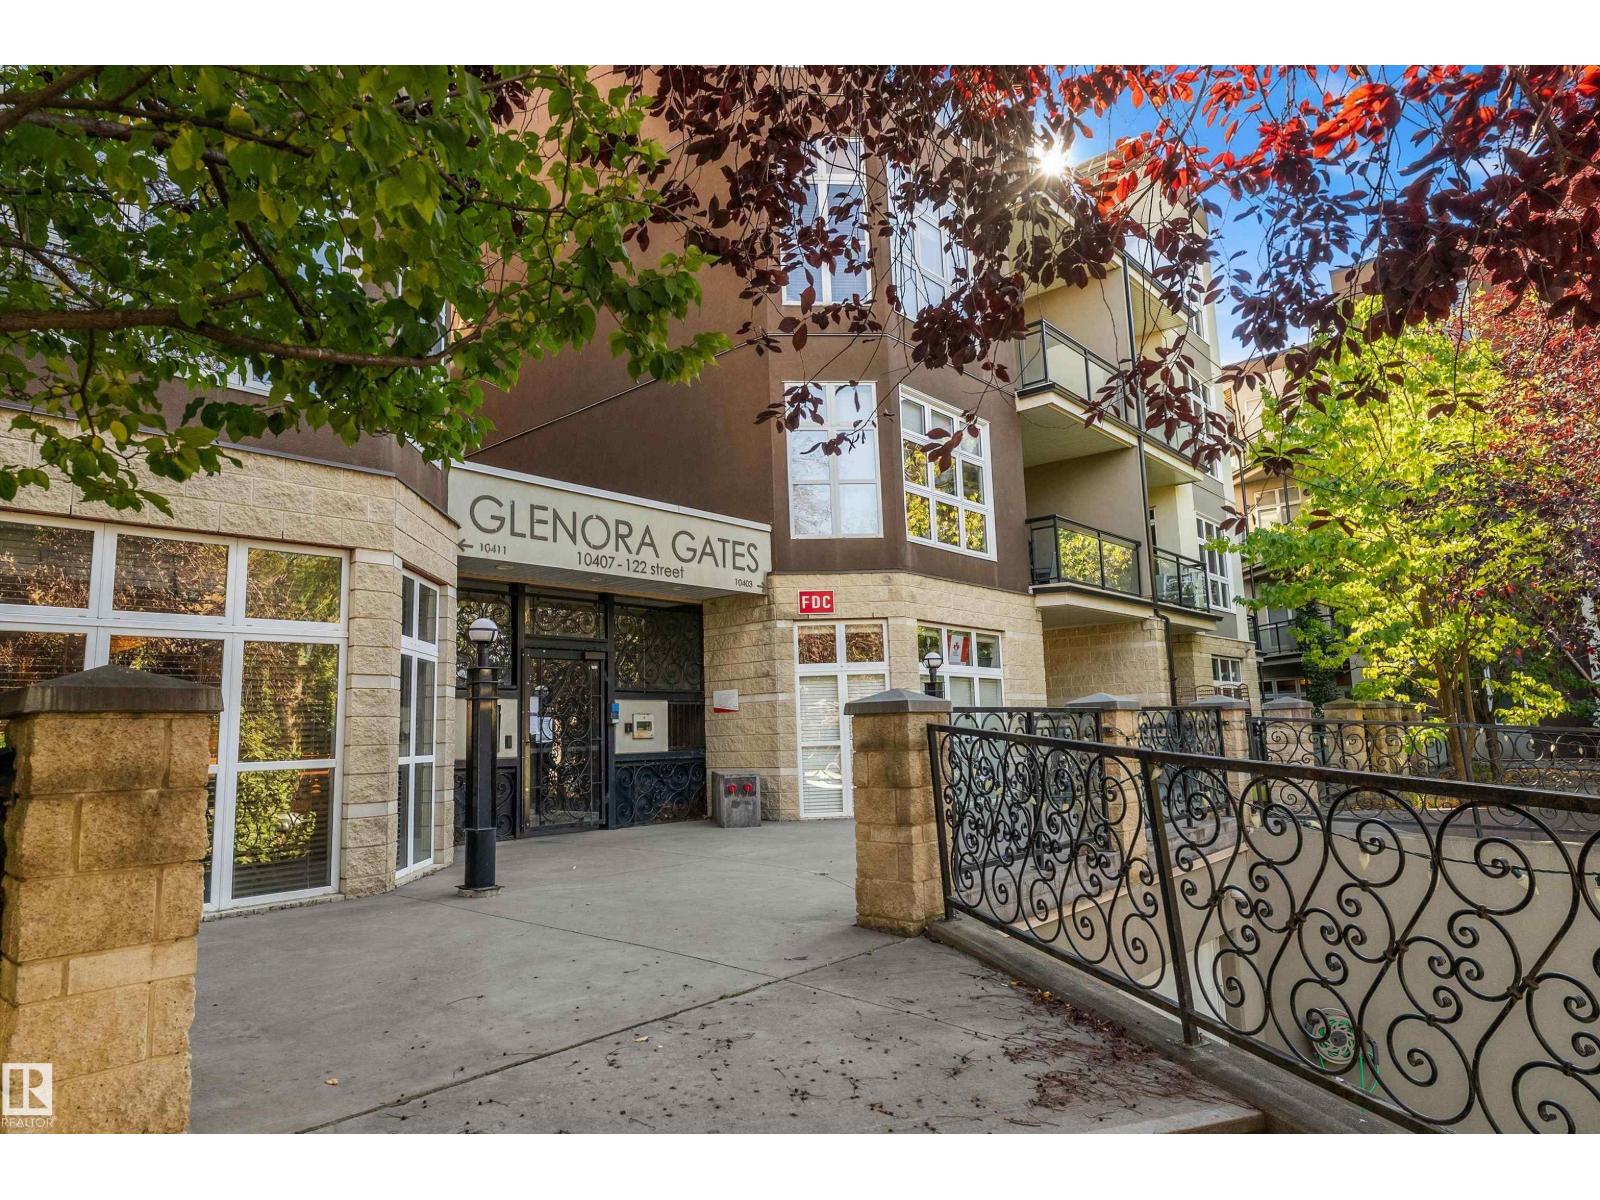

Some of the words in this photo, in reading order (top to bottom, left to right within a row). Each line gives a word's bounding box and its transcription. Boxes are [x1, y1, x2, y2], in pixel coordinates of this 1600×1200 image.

[469, 494, 660, 559] GLENORA
[671, 530, 760, 574] GATES
[479, 542, 507, 555] 10411
[650, 562, 685, 579] street
[735, 578, 753, 588] 10403
[801, 595, 832, 609] FDC
